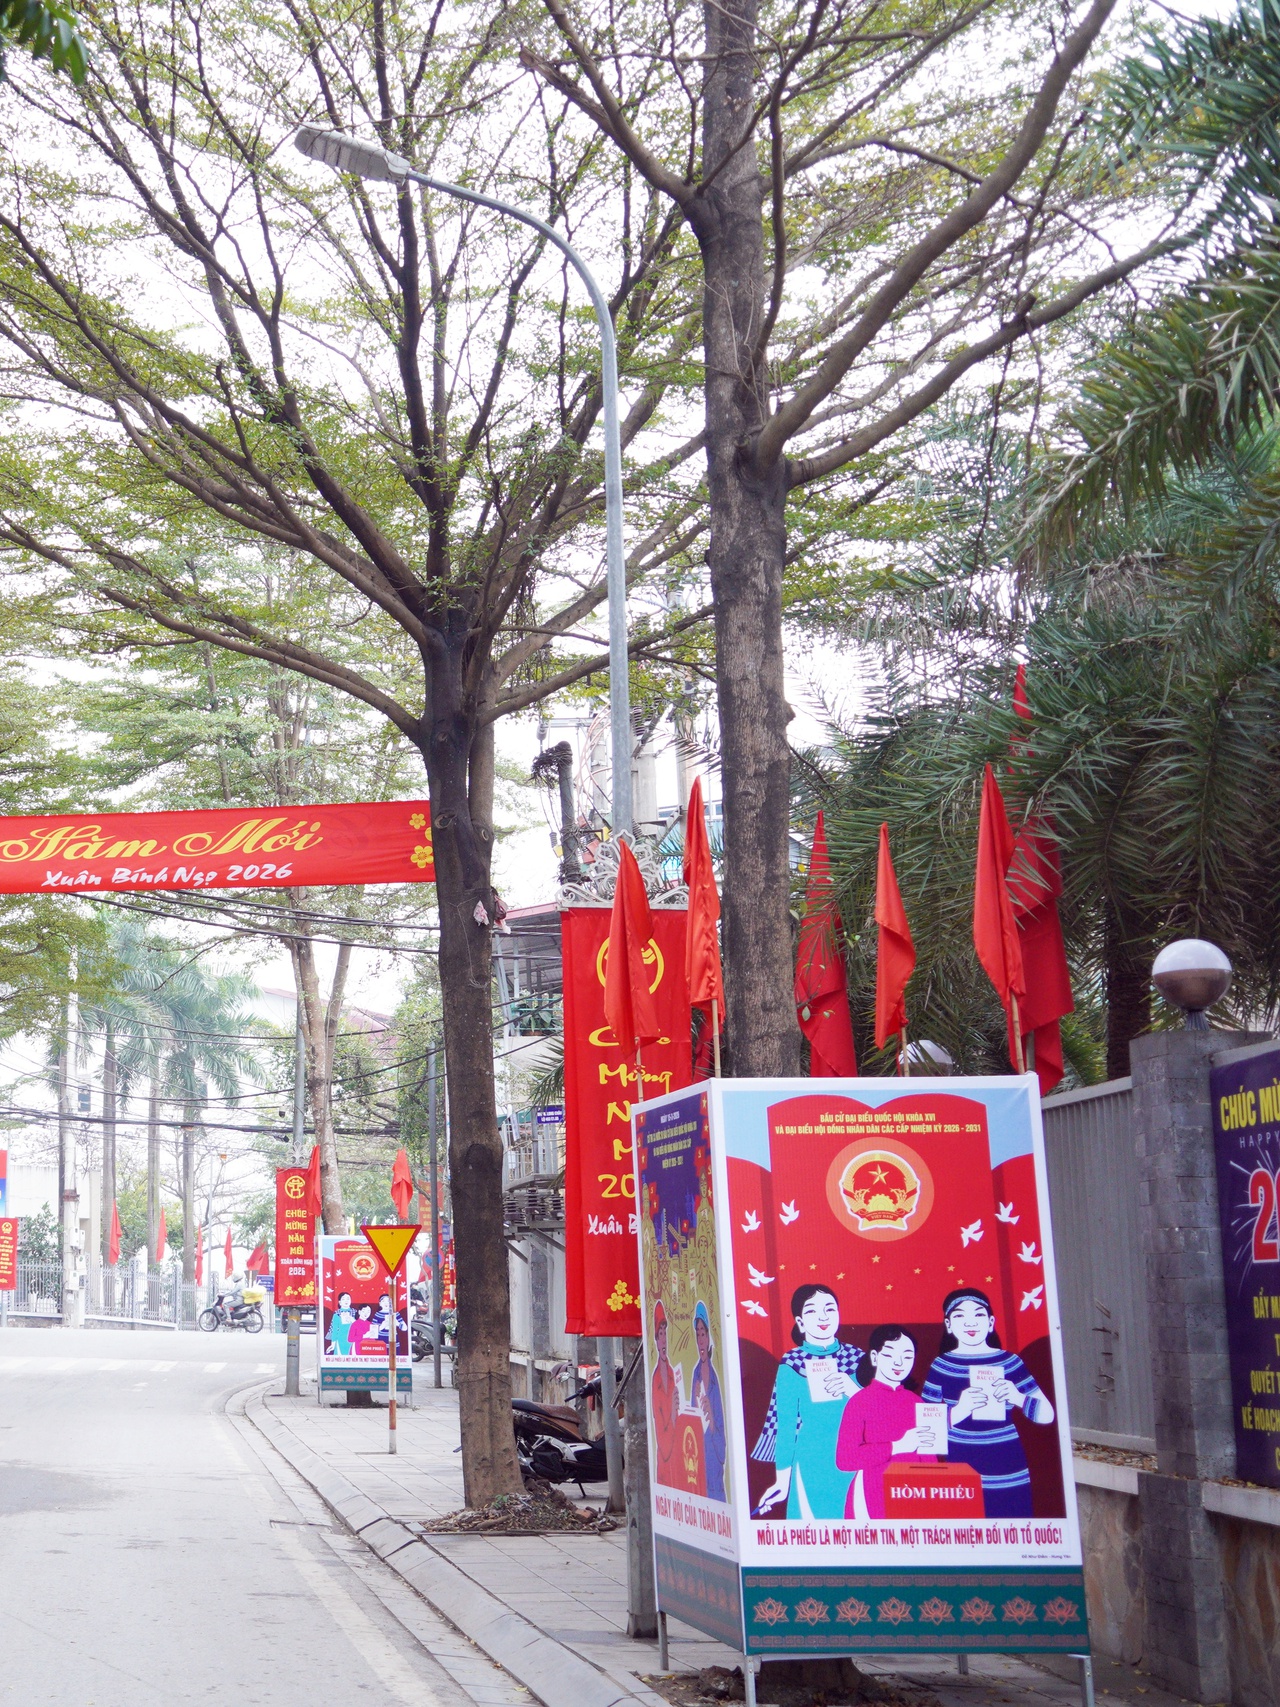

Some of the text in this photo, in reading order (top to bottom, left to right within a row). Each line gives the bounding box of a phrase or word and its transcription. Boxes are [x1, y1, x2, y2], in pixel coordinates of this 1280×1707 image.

[173, 817, 324, 857] Mới
[40, 863, 293, 888] Xuân Bính Ngọ 2026
[588, 1025, 671, 1047] Cc
[924, 1113, 935, 1121] XVI
[1221, 1085, 1256, 1131] CHÚC
[944, 1124, 959, 1133] 2026
[966, 1124, 981, 1132] 2031
[1239, 1131, 1280, 1149] HAPPY
[597, 1173, 635, 1198] 20
[285, 1208, 307, 1218] CHÚC
[588, 1214, 623, 1235] Xuân
[285, 1221, 307, 1230] MỪNG
[288, 1233, 305, 1242] NĂM
[1253, 1287, 1269, 1319] ĐẨY
[1250, 1364, 1275, 1395] QUYẾT
[1241, 1400, 1253, 1429] KẾ
[890, 1484, 975, 1499] HÒM PHIẾU
[655, 1493, 732, 1539] NGÀY HỘI CỦA TOÀN DÂN
[757, 1522, 1062, 1548] MỖI LÁ PHIẾU LÀ MỘT NIỀM TIN, MỘT TRÁCH NHIỆM ĐỐI VỚI TỔ QUỐC!
